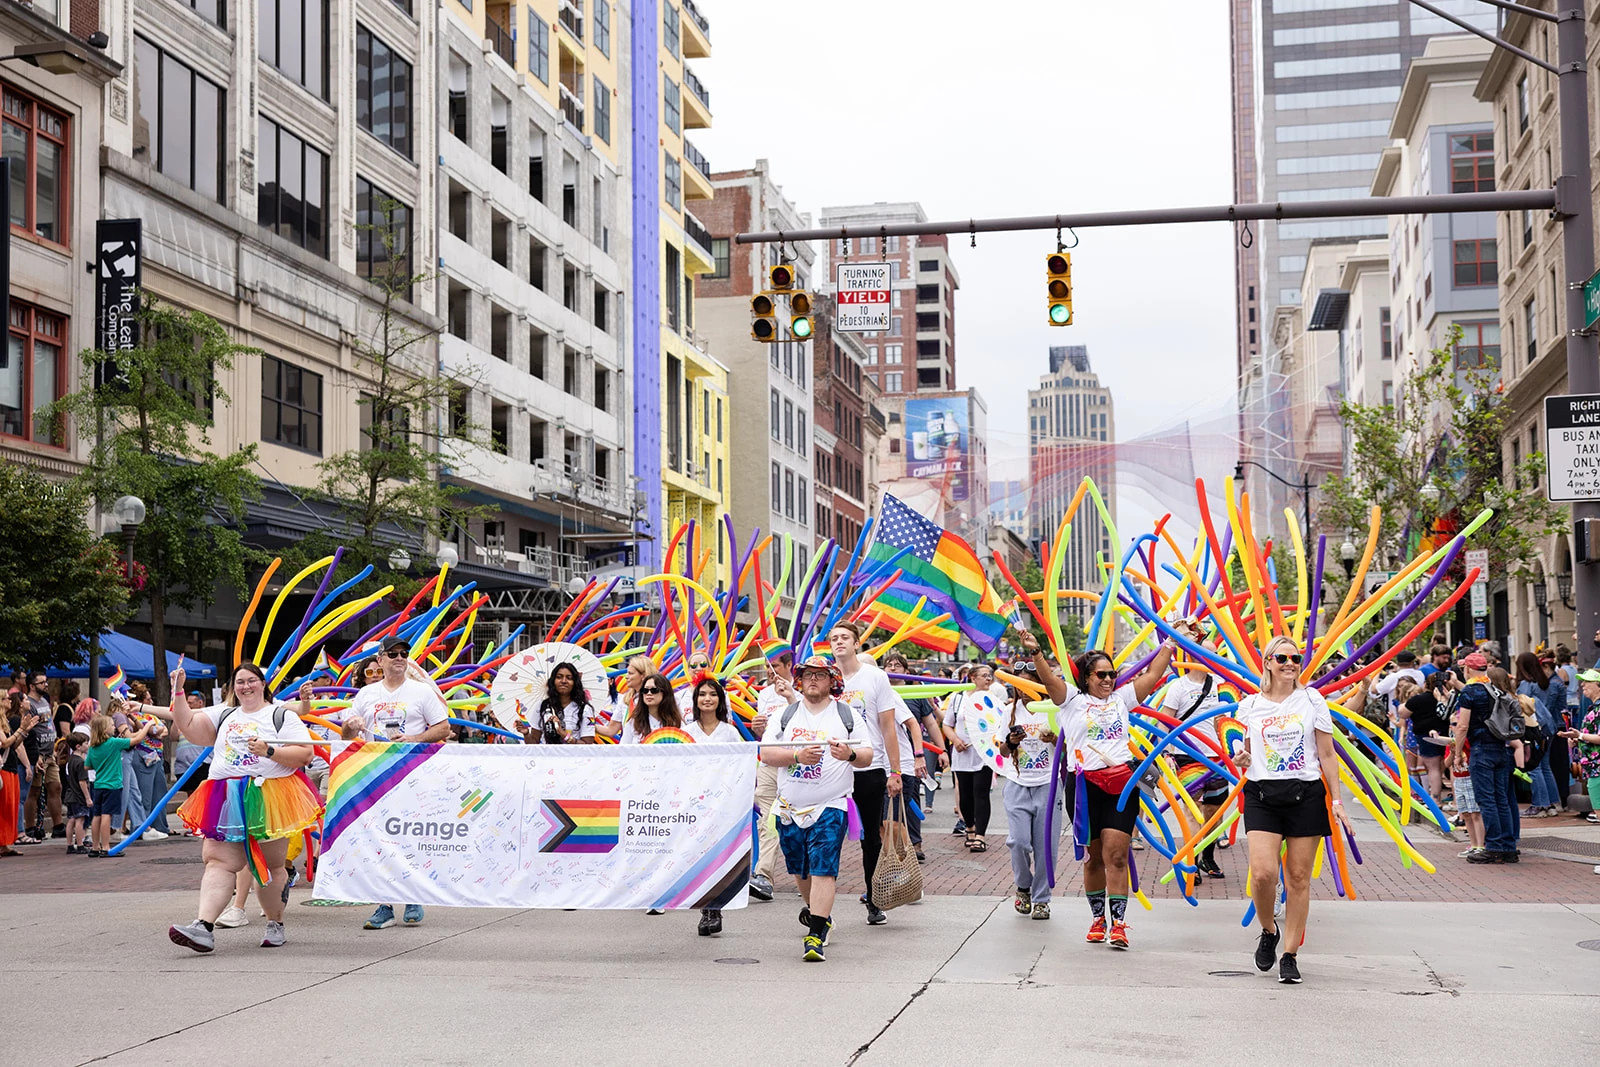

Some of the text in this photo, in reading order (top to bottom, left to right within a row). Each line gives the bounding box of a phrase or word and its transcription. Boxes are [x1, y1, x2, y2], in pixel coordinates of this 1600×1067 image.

[846, 268, 884, 279] TURNING
[847, 279, 882, 289] TRAFFIC
[120, 282, 135, 312] The
[842, 291, 887, 303] YIELD
[860, 306, 869, 315] TO
[840, 316, 888, 326] PEDESTRIANS
[104, 305, 120, 357] Compan
[1570, 400, 1600, 411] RIGHT
[1572, 413, 1600, 424] LANE
[1563, 430, 1585, 442] BUS
[1576, 444, 1598, 454] TAXI
[1573, 457, 1600, 468] ONLY
[628, 800, 660, 811] Pride
[627, 812, 697, 825] Partnership
[385, 817, 469, 840] Grange
[626, 826, 671, 837] & Allies
[418, 842, 468, 852] Insurance
